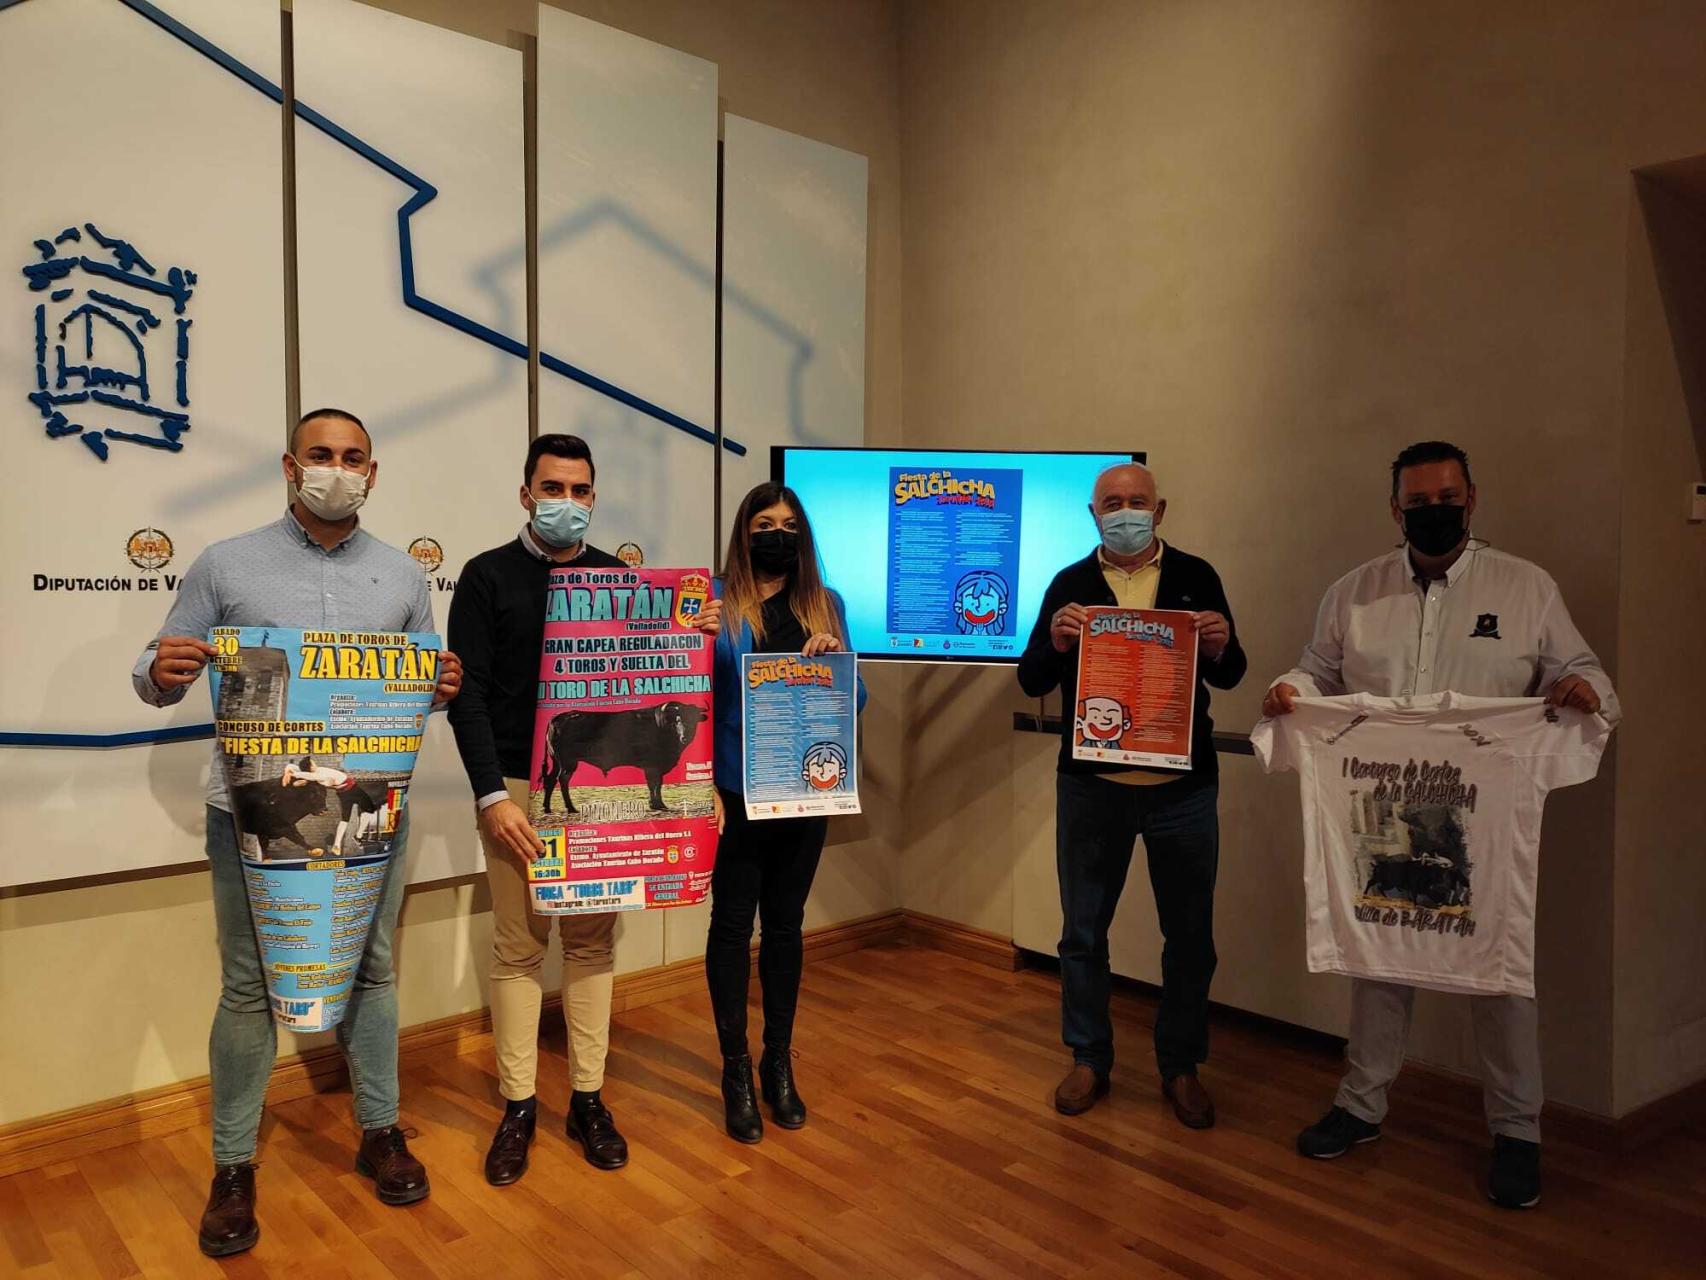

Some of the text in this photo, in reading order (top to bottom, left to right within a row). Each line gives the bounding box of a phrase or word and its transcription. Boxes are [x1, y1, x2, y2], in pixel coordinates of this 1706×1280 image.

[895, 479, 996, 506] SALCHICHA
[568, 572, 582, 584] de
[586, 572, 620, 584] Toros
[622, 572, 637, 584] de
[625, 621, 670, 631] (Valladolid)
[1088, 617, 1175, 640] SALCHICHA
[214, 636, 240, 657] 30
[303, 632, 408, 646] PLAZA DE TOROS DE
[577, 637, 615, 653] CAPEA
[299, 643, 440, 681] ZARATÁN
[555, 655, 688, 674] 4 TOROS Y SUELTA DEL
[748, 662, 833, 689] SALCHICHA
[549, 679, 587, 700] TORO
[590, 678, 609, 697] DE
[611, 677, 630, 696] LA
[634, 674, 712, 696] SALCHICHA
[218, 721, 324, 734] CONCUSO DE CORTES
[287, 736, 310, 755] DE
[311, 736, 334, 755] LA
[1351, 756, 1402, 783] Concurso
[1403, 758, 1418, 782] de
[1420, 760, 1461, 786] Cortes
[1373, 778, 1387, 801] de
[1382, 907, 1399, 926] de
